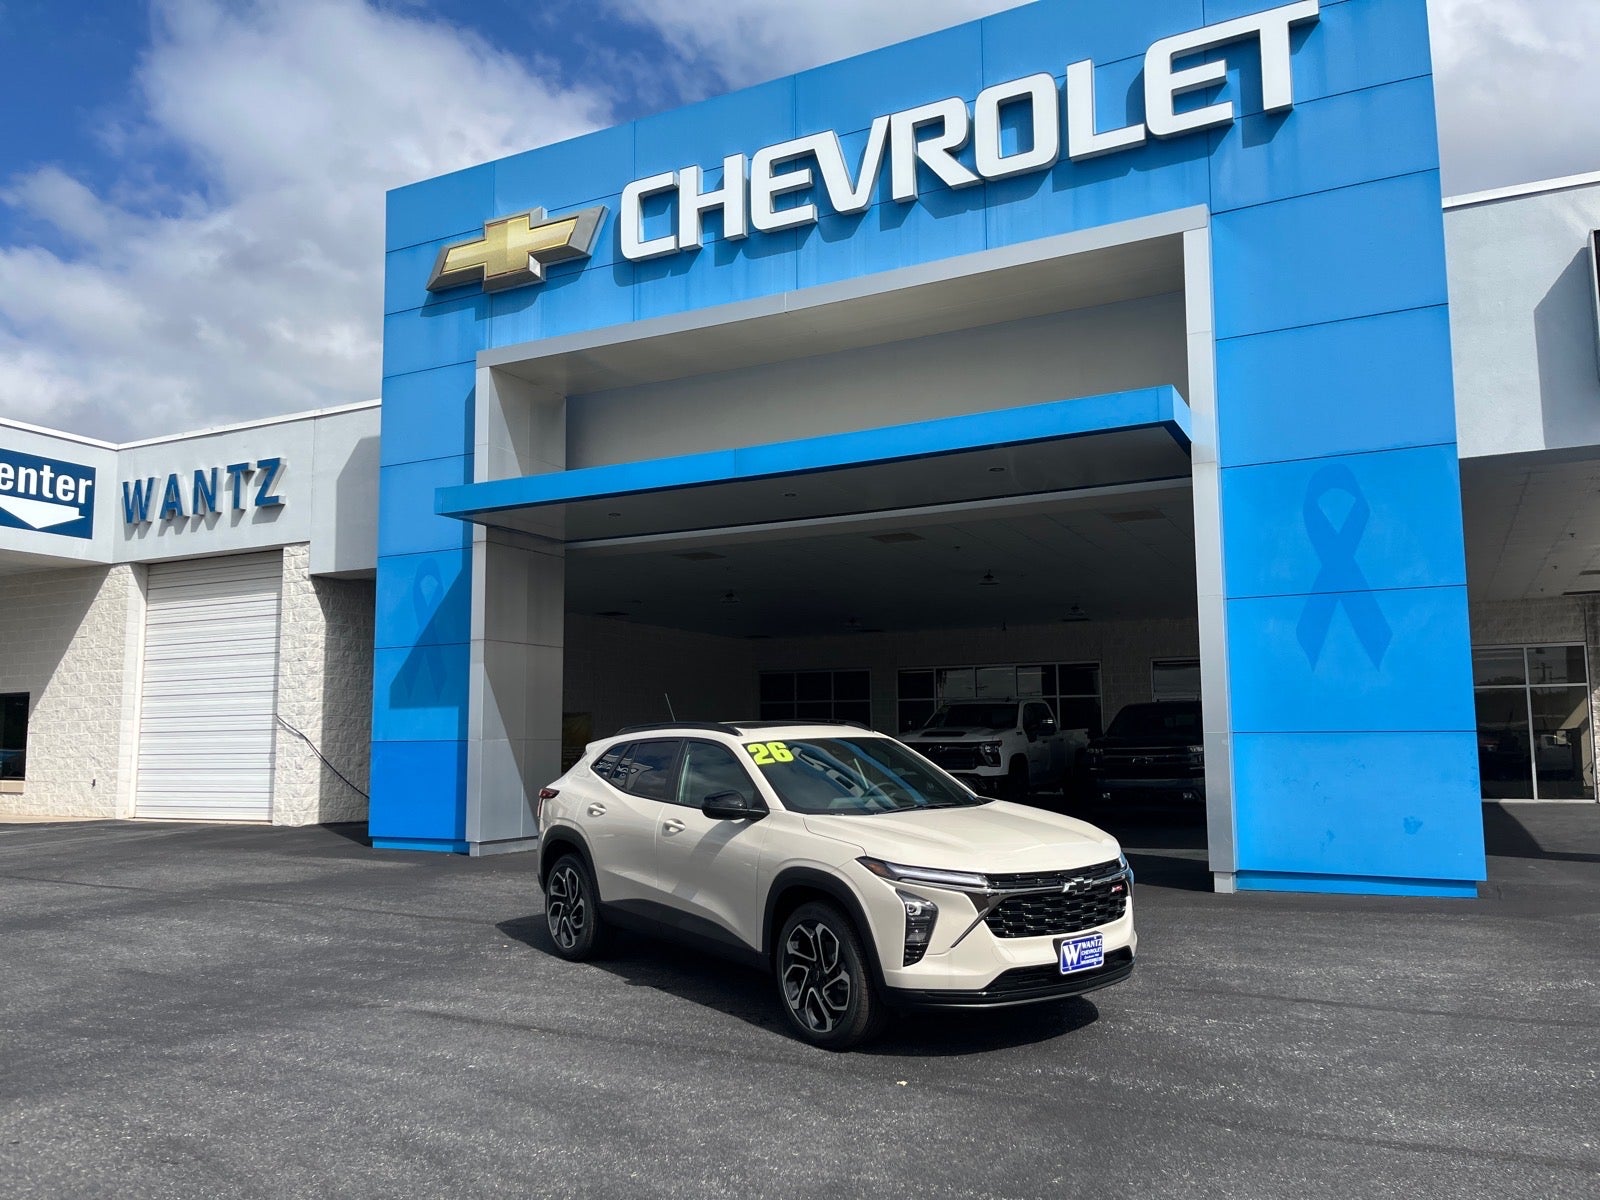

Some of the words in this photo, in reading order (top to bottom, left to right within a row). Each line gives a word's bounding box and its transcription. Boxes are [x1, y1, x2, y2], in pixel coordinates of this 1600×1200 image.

[620, 0, 1319, 261] CHEVROLET
[0, 462, 93, 504] enter
[122, 457, 286, 525] WANTZ
[747, 741, 794, 765] 26
[1063, 943, 1081, 967] W
[1082, 939, 1102, 948] WANTZ
